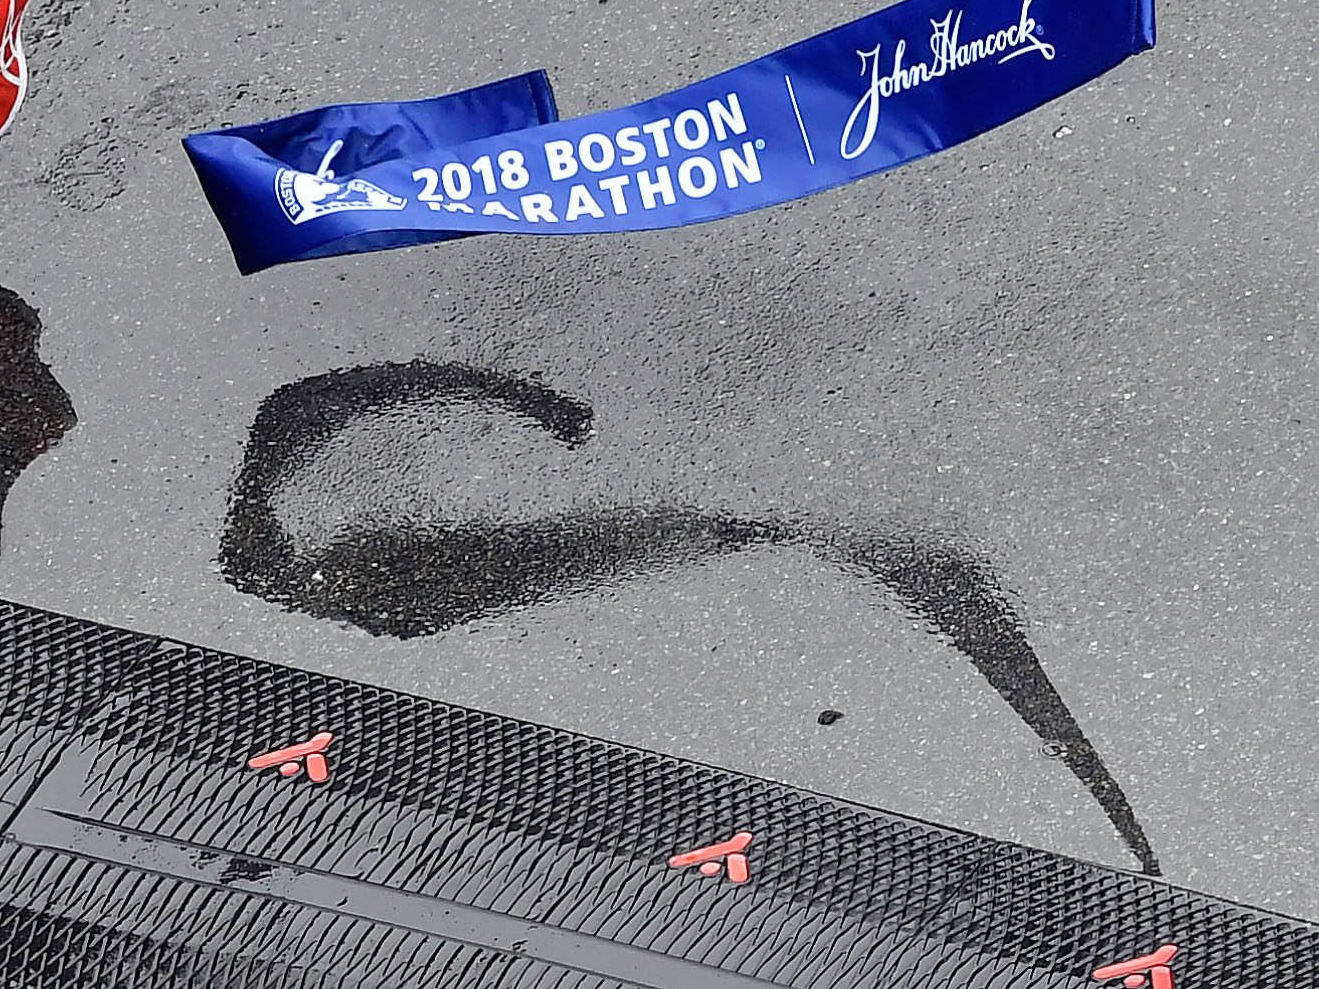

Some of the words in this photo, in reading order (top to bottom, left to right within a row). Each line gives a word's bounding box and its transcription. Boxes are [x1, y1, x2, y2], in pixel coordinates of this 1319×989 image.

[412, 150, 530, 203] 2018
[544, 92, 748, 182] BOSTON
[840, 39, 931, 160] John
